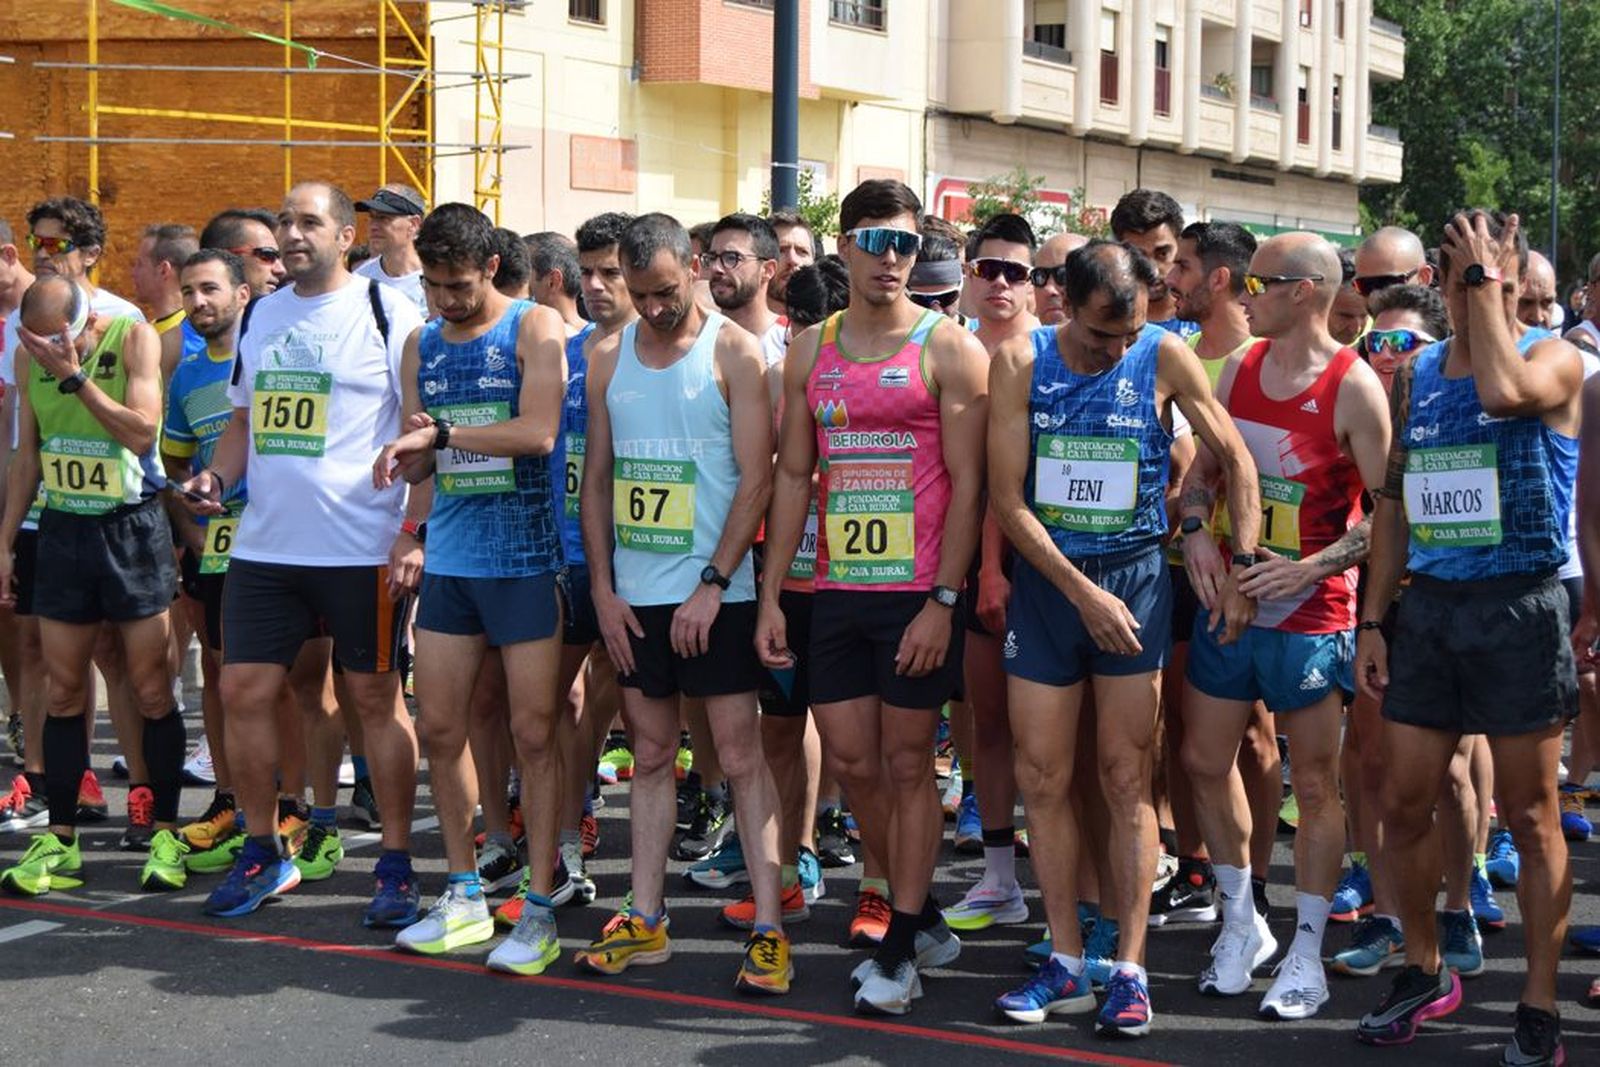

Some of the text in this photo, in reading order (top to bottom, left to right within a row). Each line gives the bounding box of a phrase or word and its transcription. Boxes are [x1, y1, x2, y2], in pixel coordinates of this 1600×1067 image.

[262, 396, 315, 430] 150
[266, 439, 320, 450] CAJA RURAL
[829, 432, 917, 448] IBERDROLA
[1067, 450, 1090, 459] CAJA
[1092, 451, 1125, 460] RURAL
[1425, 459, 1483, 471] CAJA RURAL
[51, 458, 108, 492] 104
[653, 473, 684, 482] RURAL
[455, 476, 510, 488] CAJA RURAL
[842, 478, 908, 491] ZAMORA
[1068, 479, 1103, 502] FENI
[630, 487, 670, 522] 67
[869, 503, 900, 512] RURAL
[1421, 488, 1482, 516] MARCOS
[1062, 512, 1127, 525] CAJA RURAL
[631, 533, 688, 545] CAJA RURAL
[844, 519, 888, 554] 20
[1433, 526, 1496, 540] CAJA RURAL
[849, 566, 909, 576] CAJA RURAL
